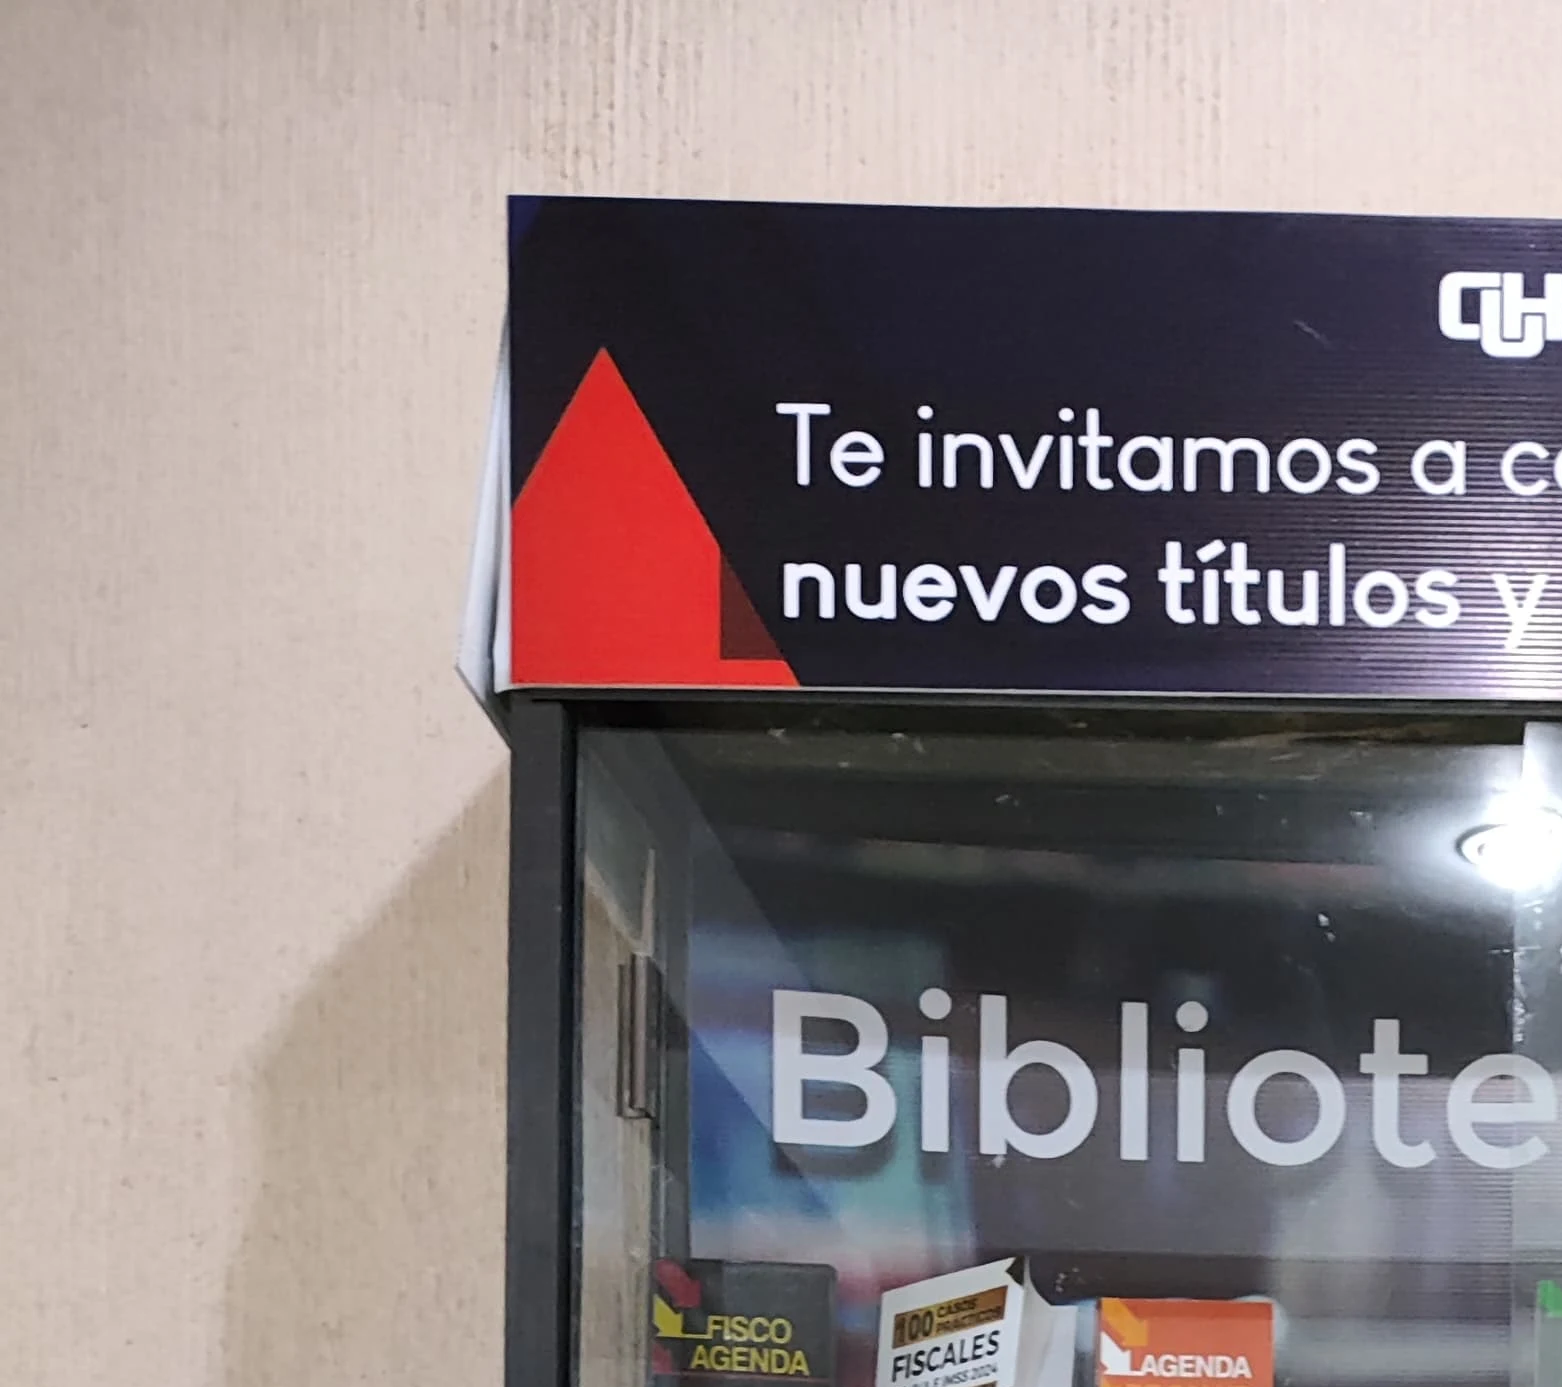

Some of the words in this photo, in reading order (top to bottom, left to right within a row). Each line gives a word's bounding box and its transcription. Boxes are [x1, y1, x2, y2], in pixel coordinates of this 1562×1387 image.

[775, 402, 886, 488] Te
[916, 405, 1382, 496] invitamos
[1410, 438, 1467, 496] a
[782, 560, 1131, 625] nuevos
[1157, 537, 1462, 629] títulos
[1493, 570, 1550, 652] y
[707, 1314, 793, 1345] FISCO
[689, 1344, 811, 1377] AGENDA
[891, 1329, 1001, 1383] FISCALES
[1141, 1354, 1252, 1379] AGENDA
